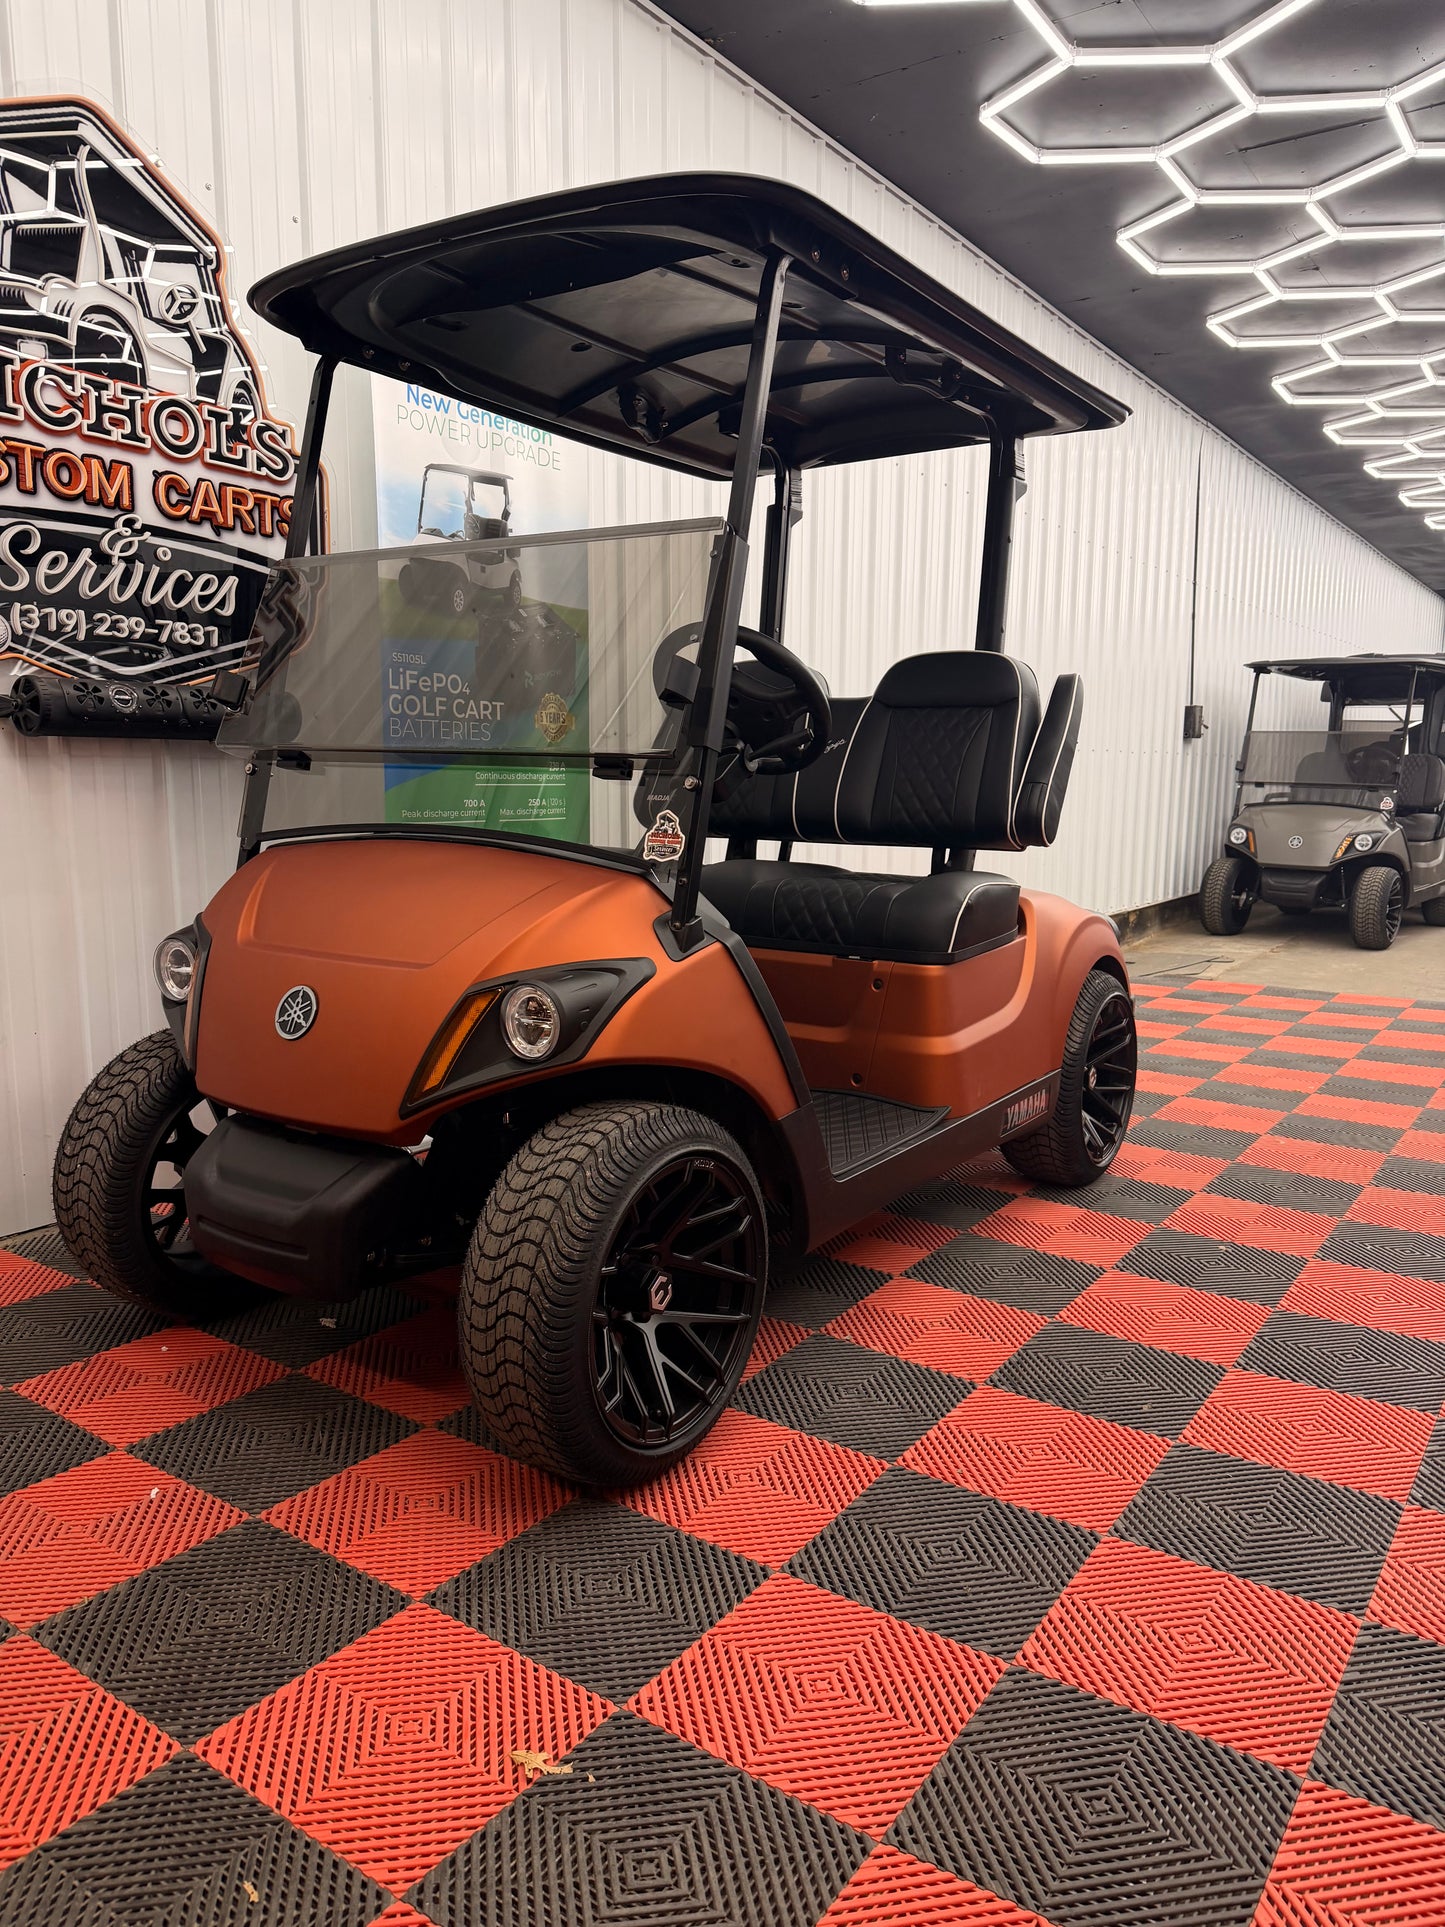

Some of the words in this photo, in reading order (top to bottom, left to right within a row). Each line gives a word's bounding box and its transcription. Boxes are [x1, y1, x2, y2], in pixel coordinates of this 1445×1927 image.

[406, 383, 451, 414] New
[456, 401, 553, 447] Generation
[397, 403, 471, 446] POWER
[476, 427, 561, 471] UPGRADE
[100, 513, 151, 566] &
[0, 523, 239, 617] Services
[10, 601, 87, 642] (319)
[92, 611, 219, 648] 239-7831
[388, 693, 448, 717] GOLF
[452, 698, 505, 721] CART
[545, 711, 566, 724] YEARS
[389, 717, 492, 742] BATTERIES
[475, 771, 516, 780] Continuous
[516, 772, 546, 782] discharge
[401, 809, 422, 818] Peak
[423, 809, 459, 819] discharge
[460, 809, 486, 817] current
[463, 799, 478, 807] 700
[480, 799, 486, 807] A
[499, 808, 514, 816] Max.
[516, 807, 546, 817] discharge
[547, 806, 566, 815] current
[528, 798, 541, 807] 250
[541, 798, 547, 807] A
[1006, 1088, 1047, 1131] YAMAHA
